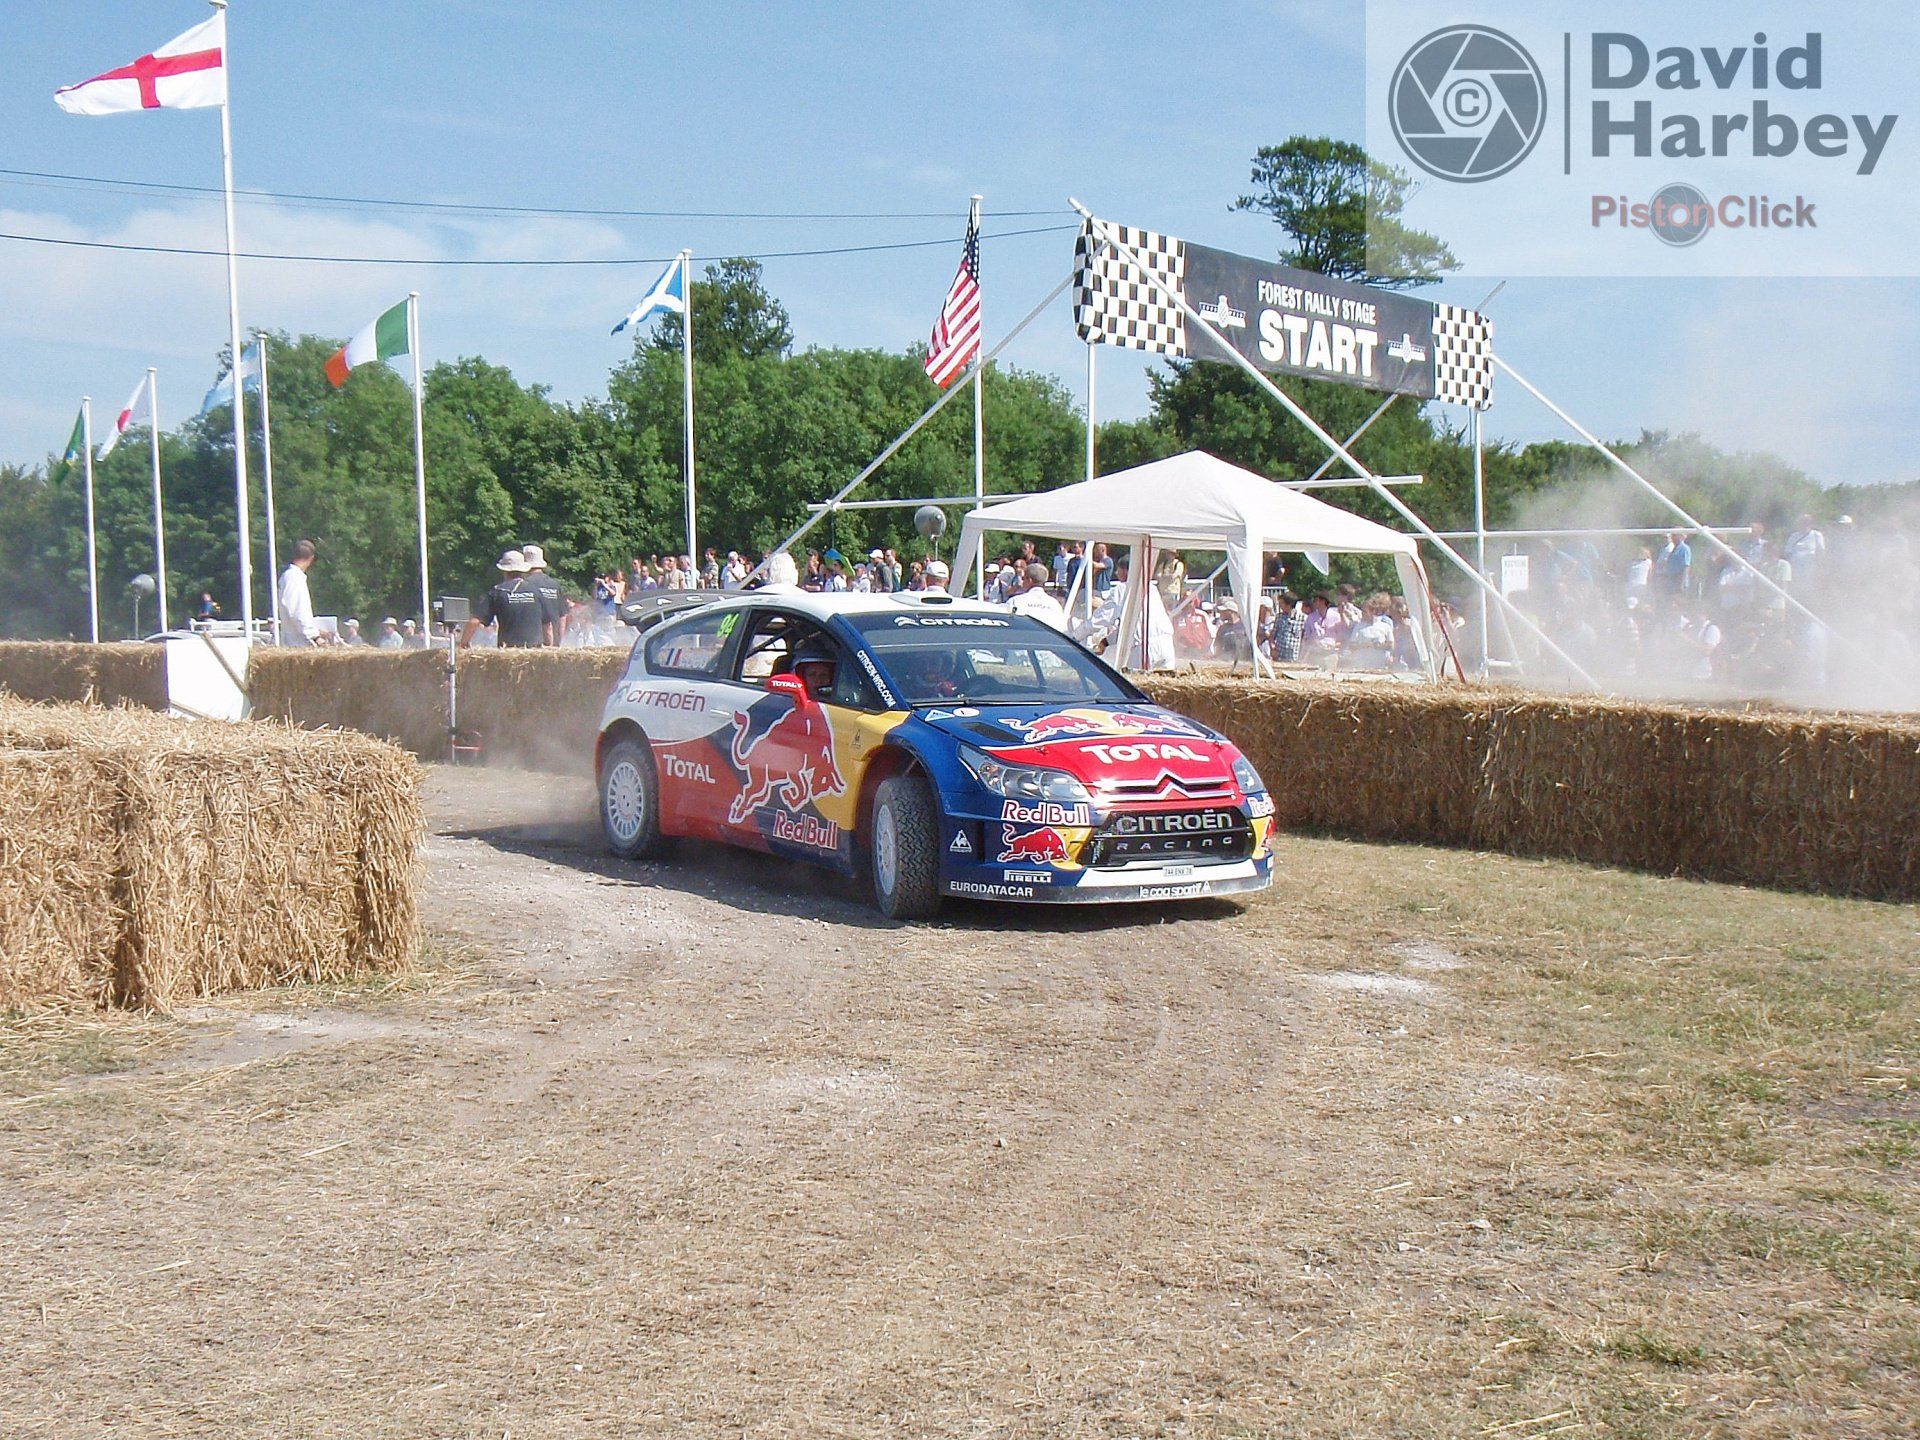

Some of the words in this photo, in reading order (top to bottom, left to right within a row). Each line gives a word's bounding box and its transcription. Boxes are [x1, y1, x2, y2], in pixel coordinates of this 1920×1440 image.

[1257, 280, 1302, 311] FOREST
[1304, 290, 1340, 318] RALLY
[1342, 298, 1377, 326] STAGE
[1257, 308, 1378, 378] START
[717, 613, 740, 639] 94
[771, 679, 797, 689] TOTAL
[626, 690, 705, 712] CITROËN
[1079, 743, 1210, 765] TOTAL
[663, 754, 716, 784] TOTAL
[1001, 799, 1045, 823] Red
[1046, 803, 1090, 826] Bull
[1116, 809, 1233, 833] CITROËN
[773, 809, 805, 842] Red
[805, 813, 838, 850] Bull
[1116, 836, 1233, 851] RACING
[1003, 869, 1052, 883] PIRELLI
[949, 880, 1034, 898] EURODATACAR
[1138, 884, 1150, 898] le
[1150, 886, 1171, 899] coq
[1171, 881, 1203, 898] sportif
